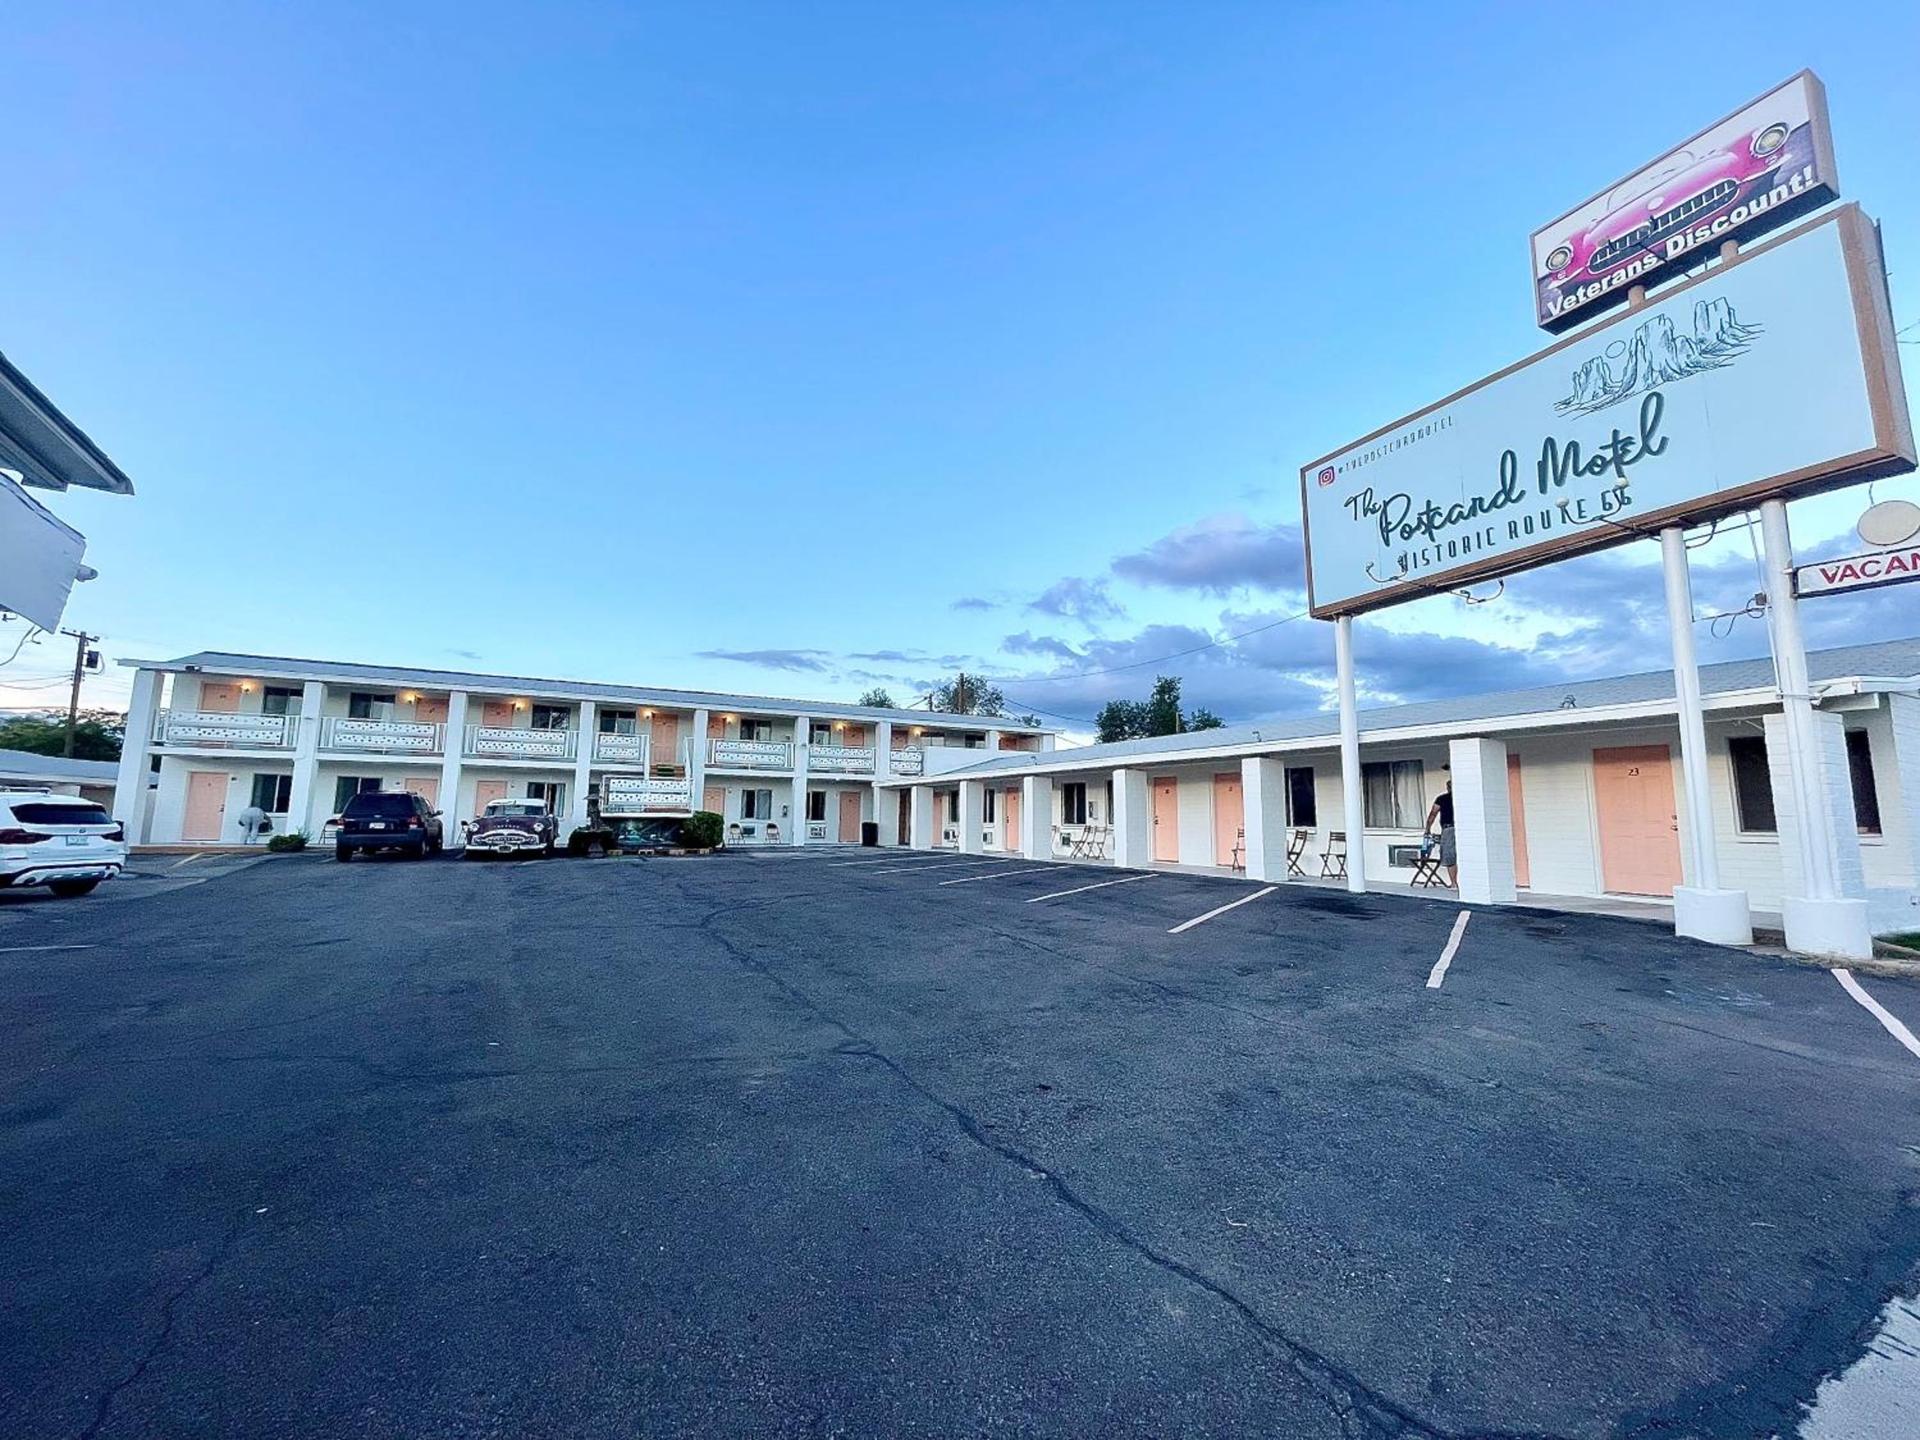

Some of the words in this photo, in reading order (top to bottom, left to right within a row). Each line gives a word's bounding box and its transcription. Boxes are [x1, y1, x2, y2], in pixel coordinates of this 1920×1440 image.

[1547, 254, 1660, 317] Veterans
[1664, 165, 1817, 259] Discount!
[1343, 487, 1382, 521] The
[1379, 449, 1526, 547] Postcard
[1536, 391, 1669, 495] Motel
[1600, 486, 1633, 512] 66
